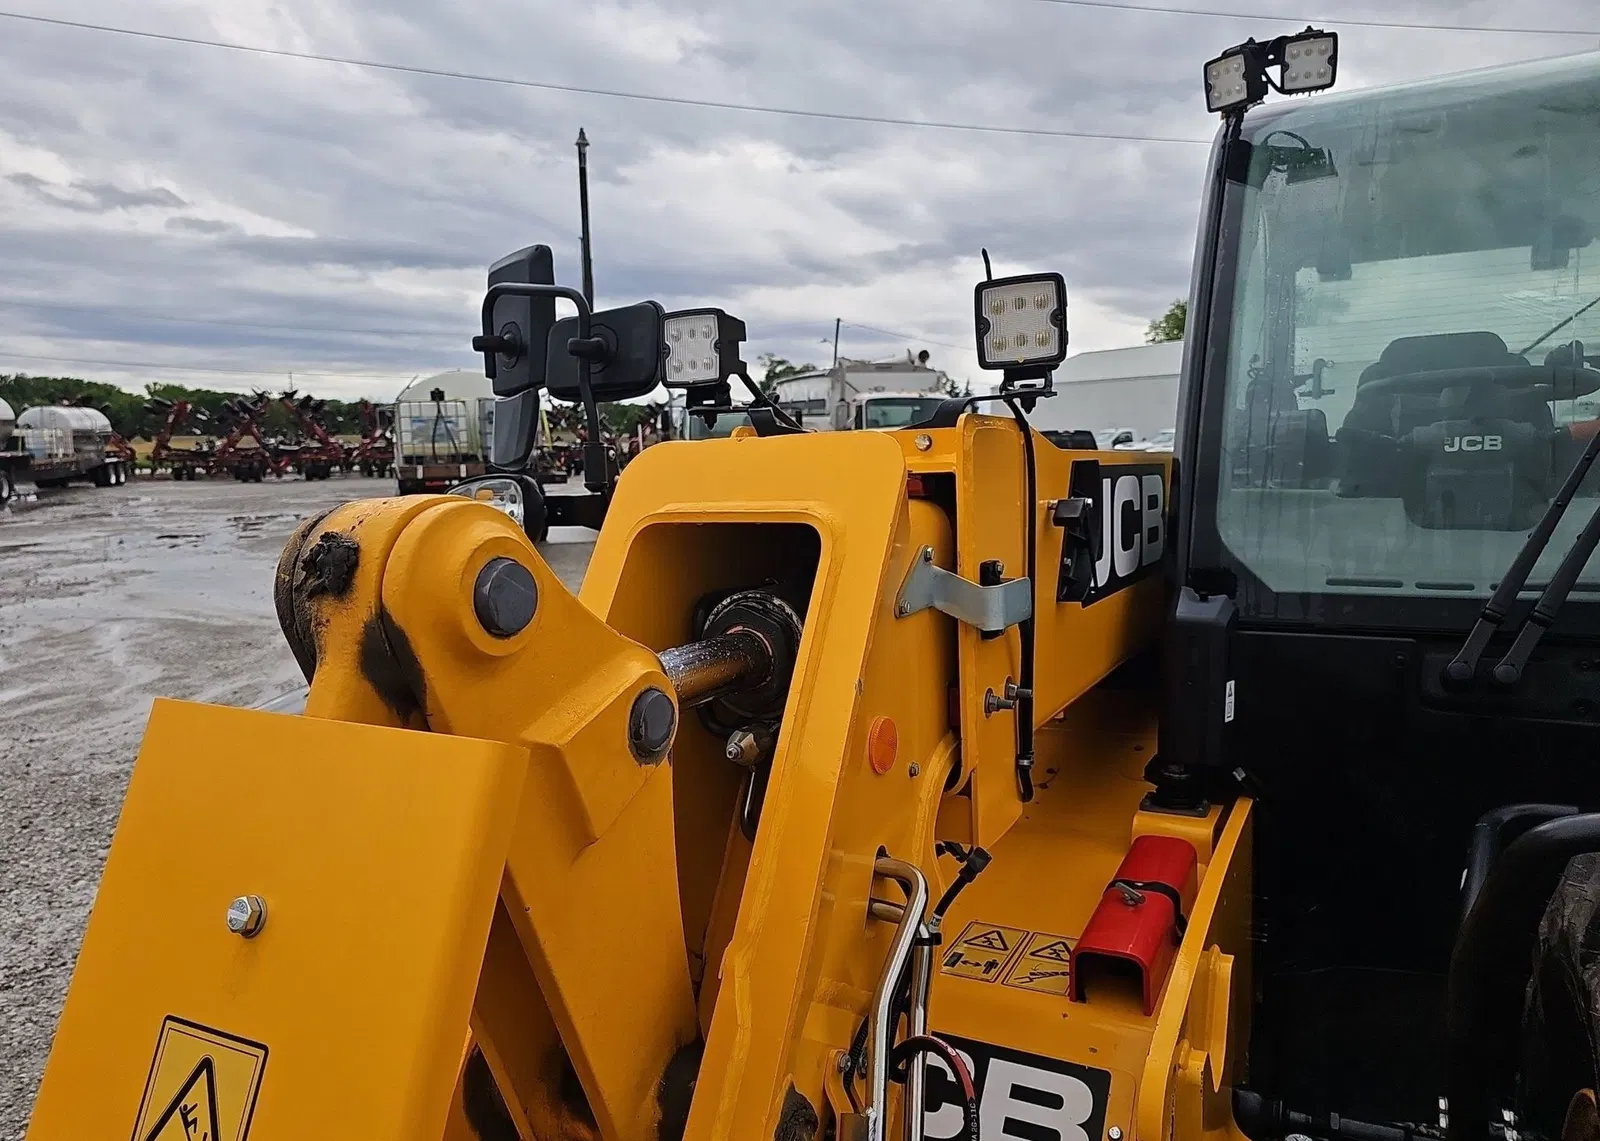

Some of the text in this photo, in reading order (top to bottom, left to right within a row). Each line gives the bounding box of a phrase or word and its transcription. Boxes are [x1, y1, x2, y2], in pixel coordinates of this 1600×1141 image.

[1444, 435, 1502, 452] JCB
[1095, 474, 1164, 588] JCB
[922, 1048, 1094, 1141] CB
